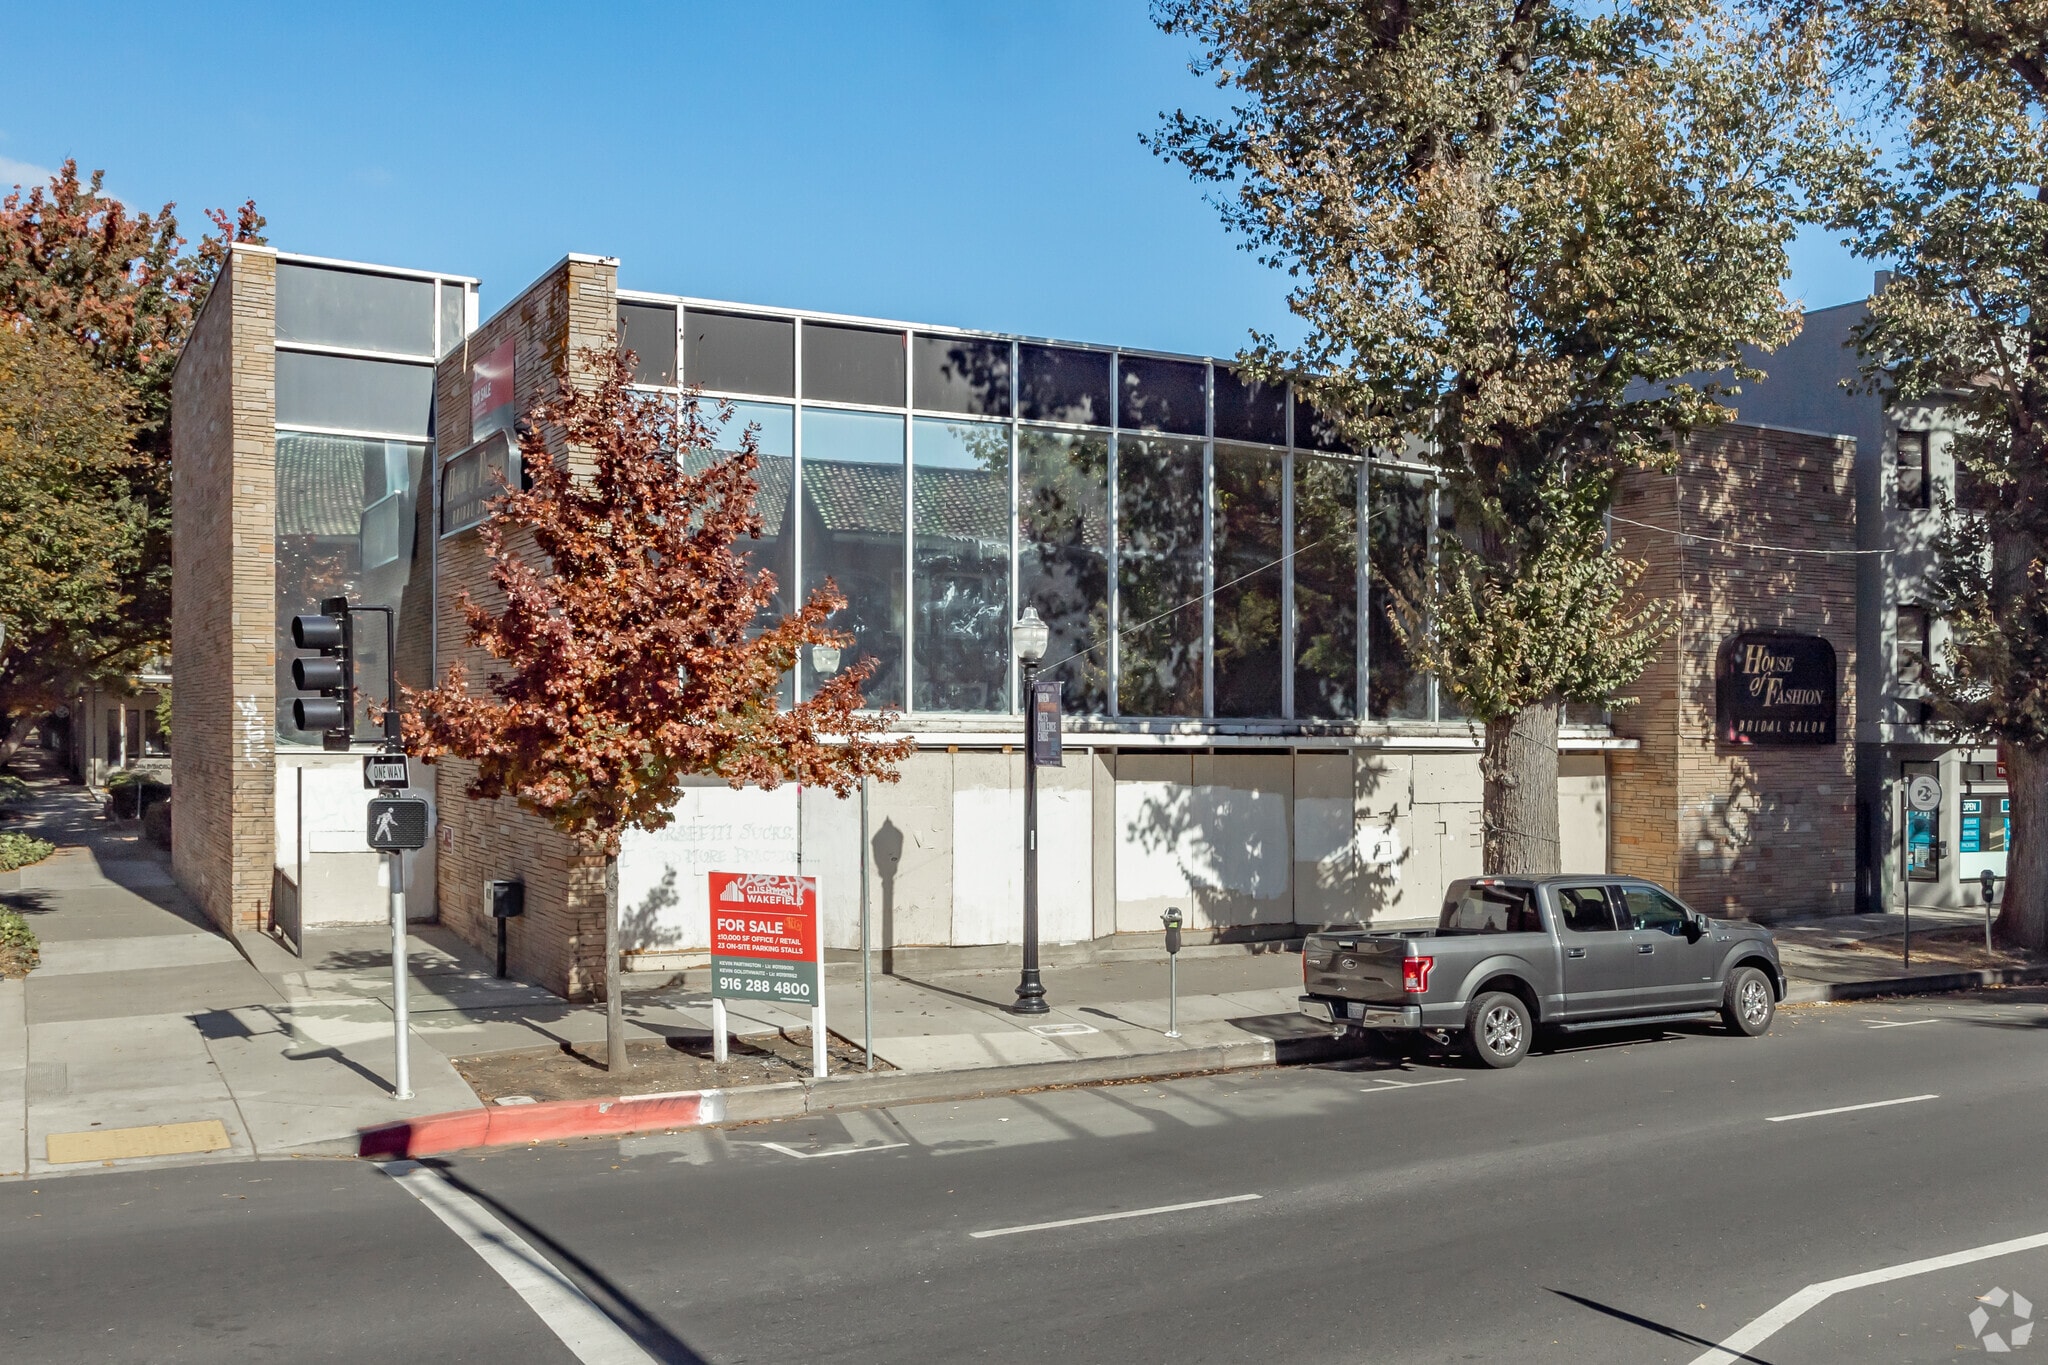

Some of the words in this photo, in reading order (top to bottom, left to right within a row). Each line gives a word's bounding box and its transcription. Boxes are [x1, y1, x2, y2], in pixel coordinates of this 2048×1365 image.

[480, 382, 492, 402] SALE
[1742, 644, 1794, 674] HOUSE
[1749, 671, 1771, 697] of
[1762, 677, 1824, 707] FASHION
[1738, 720, 1781, 732] BRIDAL
[1789, 721, 1826, 733] SALON
[373, 765, 386, 779] ONE
[387, 765, 403, 779] WAY
[1963, 802, 1977, 811] OPEN
[746, 885, 795, 896] CUSHMAN
[747, 894, 804, 906] WAKEFIELD
[717, 918, 746, 933] FOR
[749, 920, 784, 934] SALE
[751, 936, 774, 944] OFFICE
[780, 937, 802, 946] RETAIL
[726, 943, 751, 951] ON-SITE
[752, 945, 780, 953] PARKING
[781, 946, 804, 955] STALLS
[719, 977, 742, 991] 916
[745, 978, 770, 993] 288
[773, 981, 810, 996] 4800
